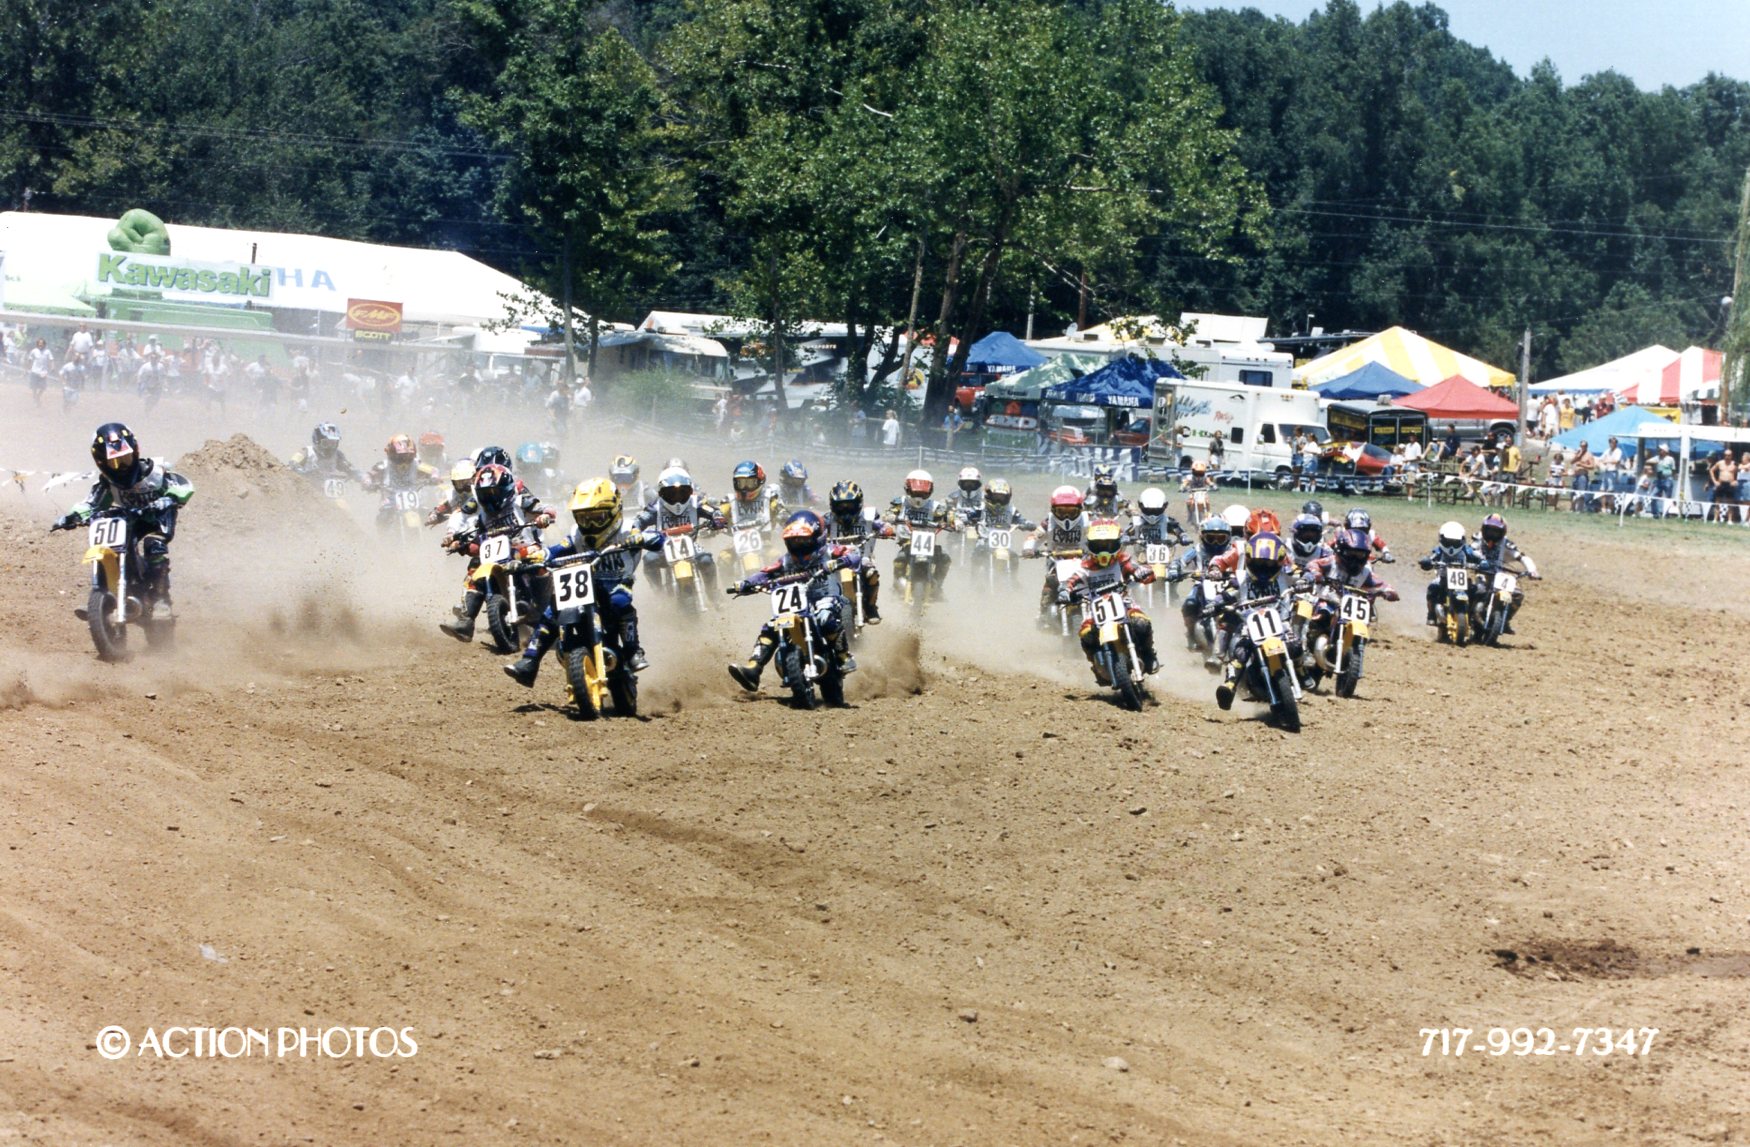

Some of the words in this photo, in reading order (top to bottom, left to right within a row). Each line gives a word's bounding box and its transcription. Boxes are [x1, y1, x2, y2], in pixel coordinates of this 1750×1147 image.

[98, 252, 271, 297] Kawasaki
[352, 309, 395, 322] FMF
[355, 331, 393, 341] SCOTT
[987, 364, 1017, 374] YAMAHA
[1107, 395, 1140, 407] YAMAHA
[401, 491, 417, 509] 19
[94, 520, 118, 545] 50
[991, 532, 1009, 548] 30
[485, 540, 502, 559] 37
[669, 540, 690, 560] 14
[738, 534, 760, 553] 26
[913, 534, 933, 553] 44
[1149, 547, 1166, 562] 36
[559, 570, 589, 602] 38
[1450, 571, 1465, 586] 48
[1501, 578, 1508, 589] 4
[775, 586, 802, 614] 24
[1094, 595, 1118, 619] 51
[1343, 597, 1366, 625] 45
[1252, 610, 1277, 637] 11
